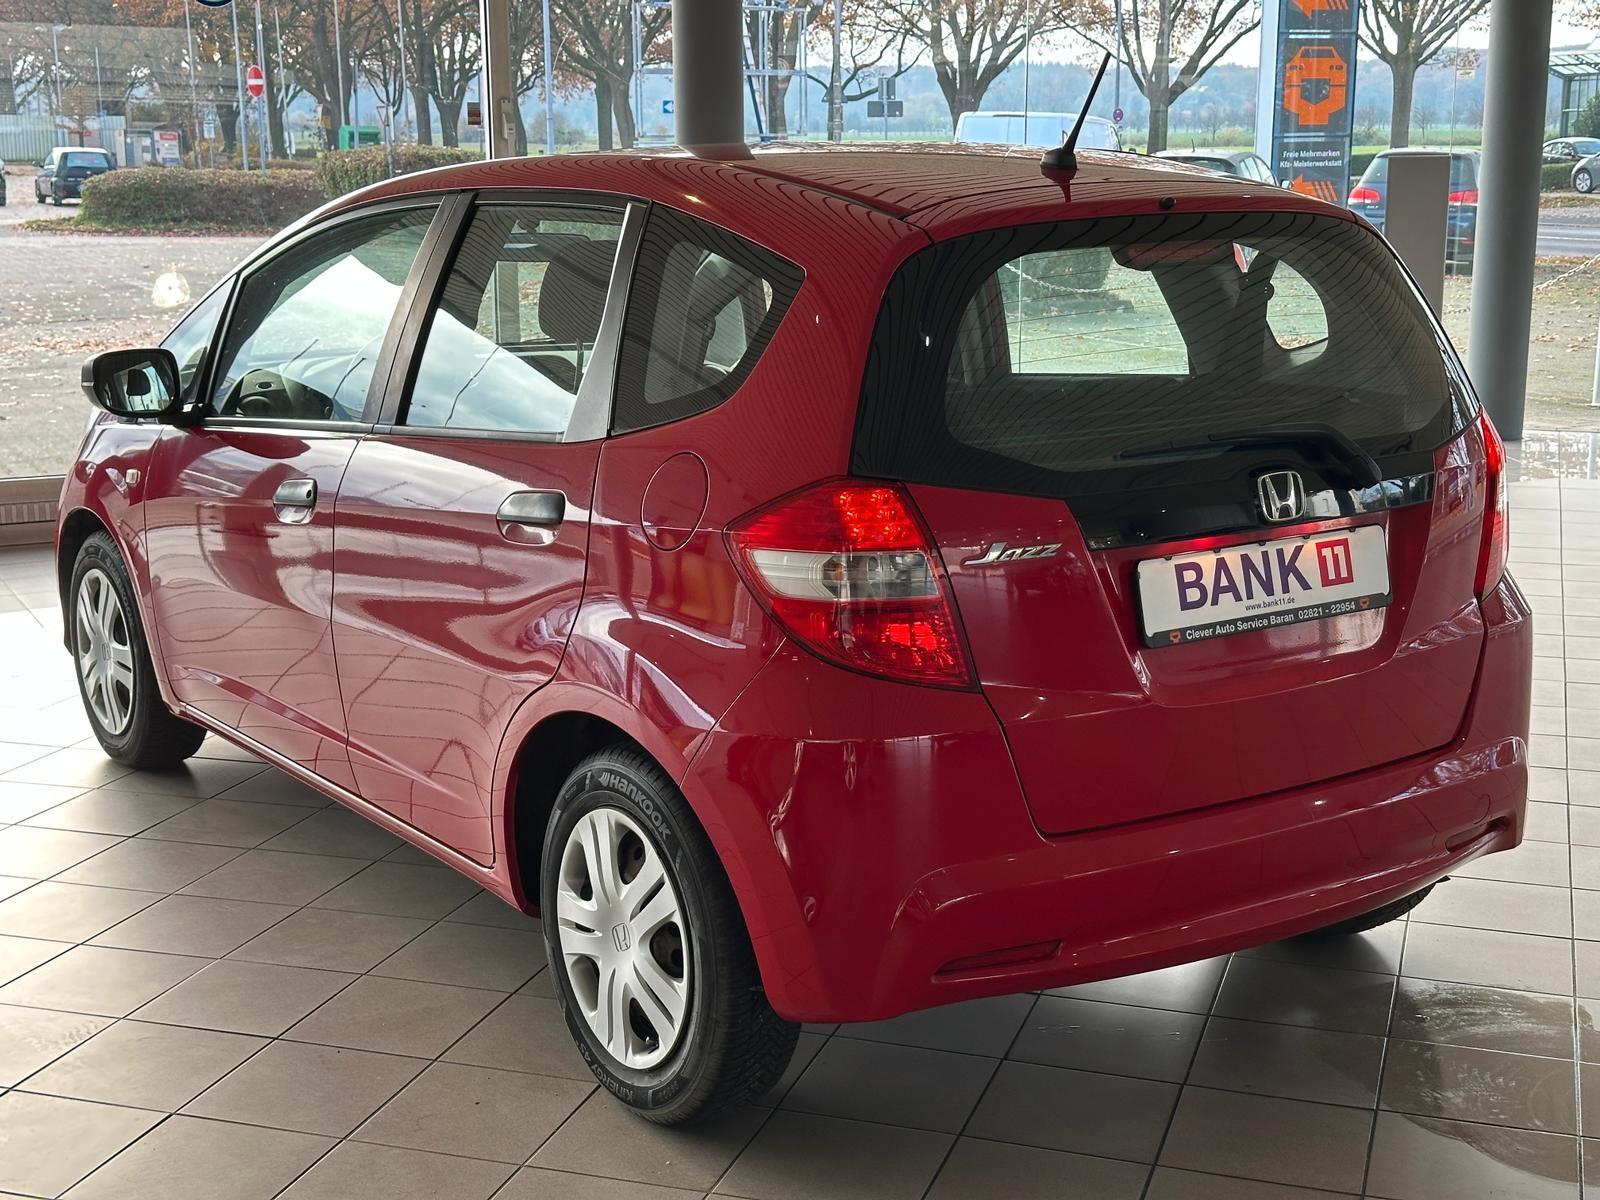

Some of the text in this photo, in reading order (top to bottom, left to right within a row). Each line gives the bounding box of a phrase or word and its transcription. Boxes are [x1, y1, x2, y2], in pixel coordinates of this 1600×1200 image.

[1300, 150, 1340, 158] Mehrmarken
[1293, 160, 1342, 168] Meisterwerkstatt
[963, 541, 1063, 565] Jazz
[1174, 543, 1350, 611] BANK 11
[1245, 596, 1296, 611] www.bank11.de
[1185, 628, 1213, 640] Clever
[1215, 623, 1235, 635] Auto
[1237, 618, 1268, 632] Service
[1270, 613, 1295, 625] Baran
[1298, 607, 1323, 620] 02821
[1331, 601, 1356, 614] 22954
